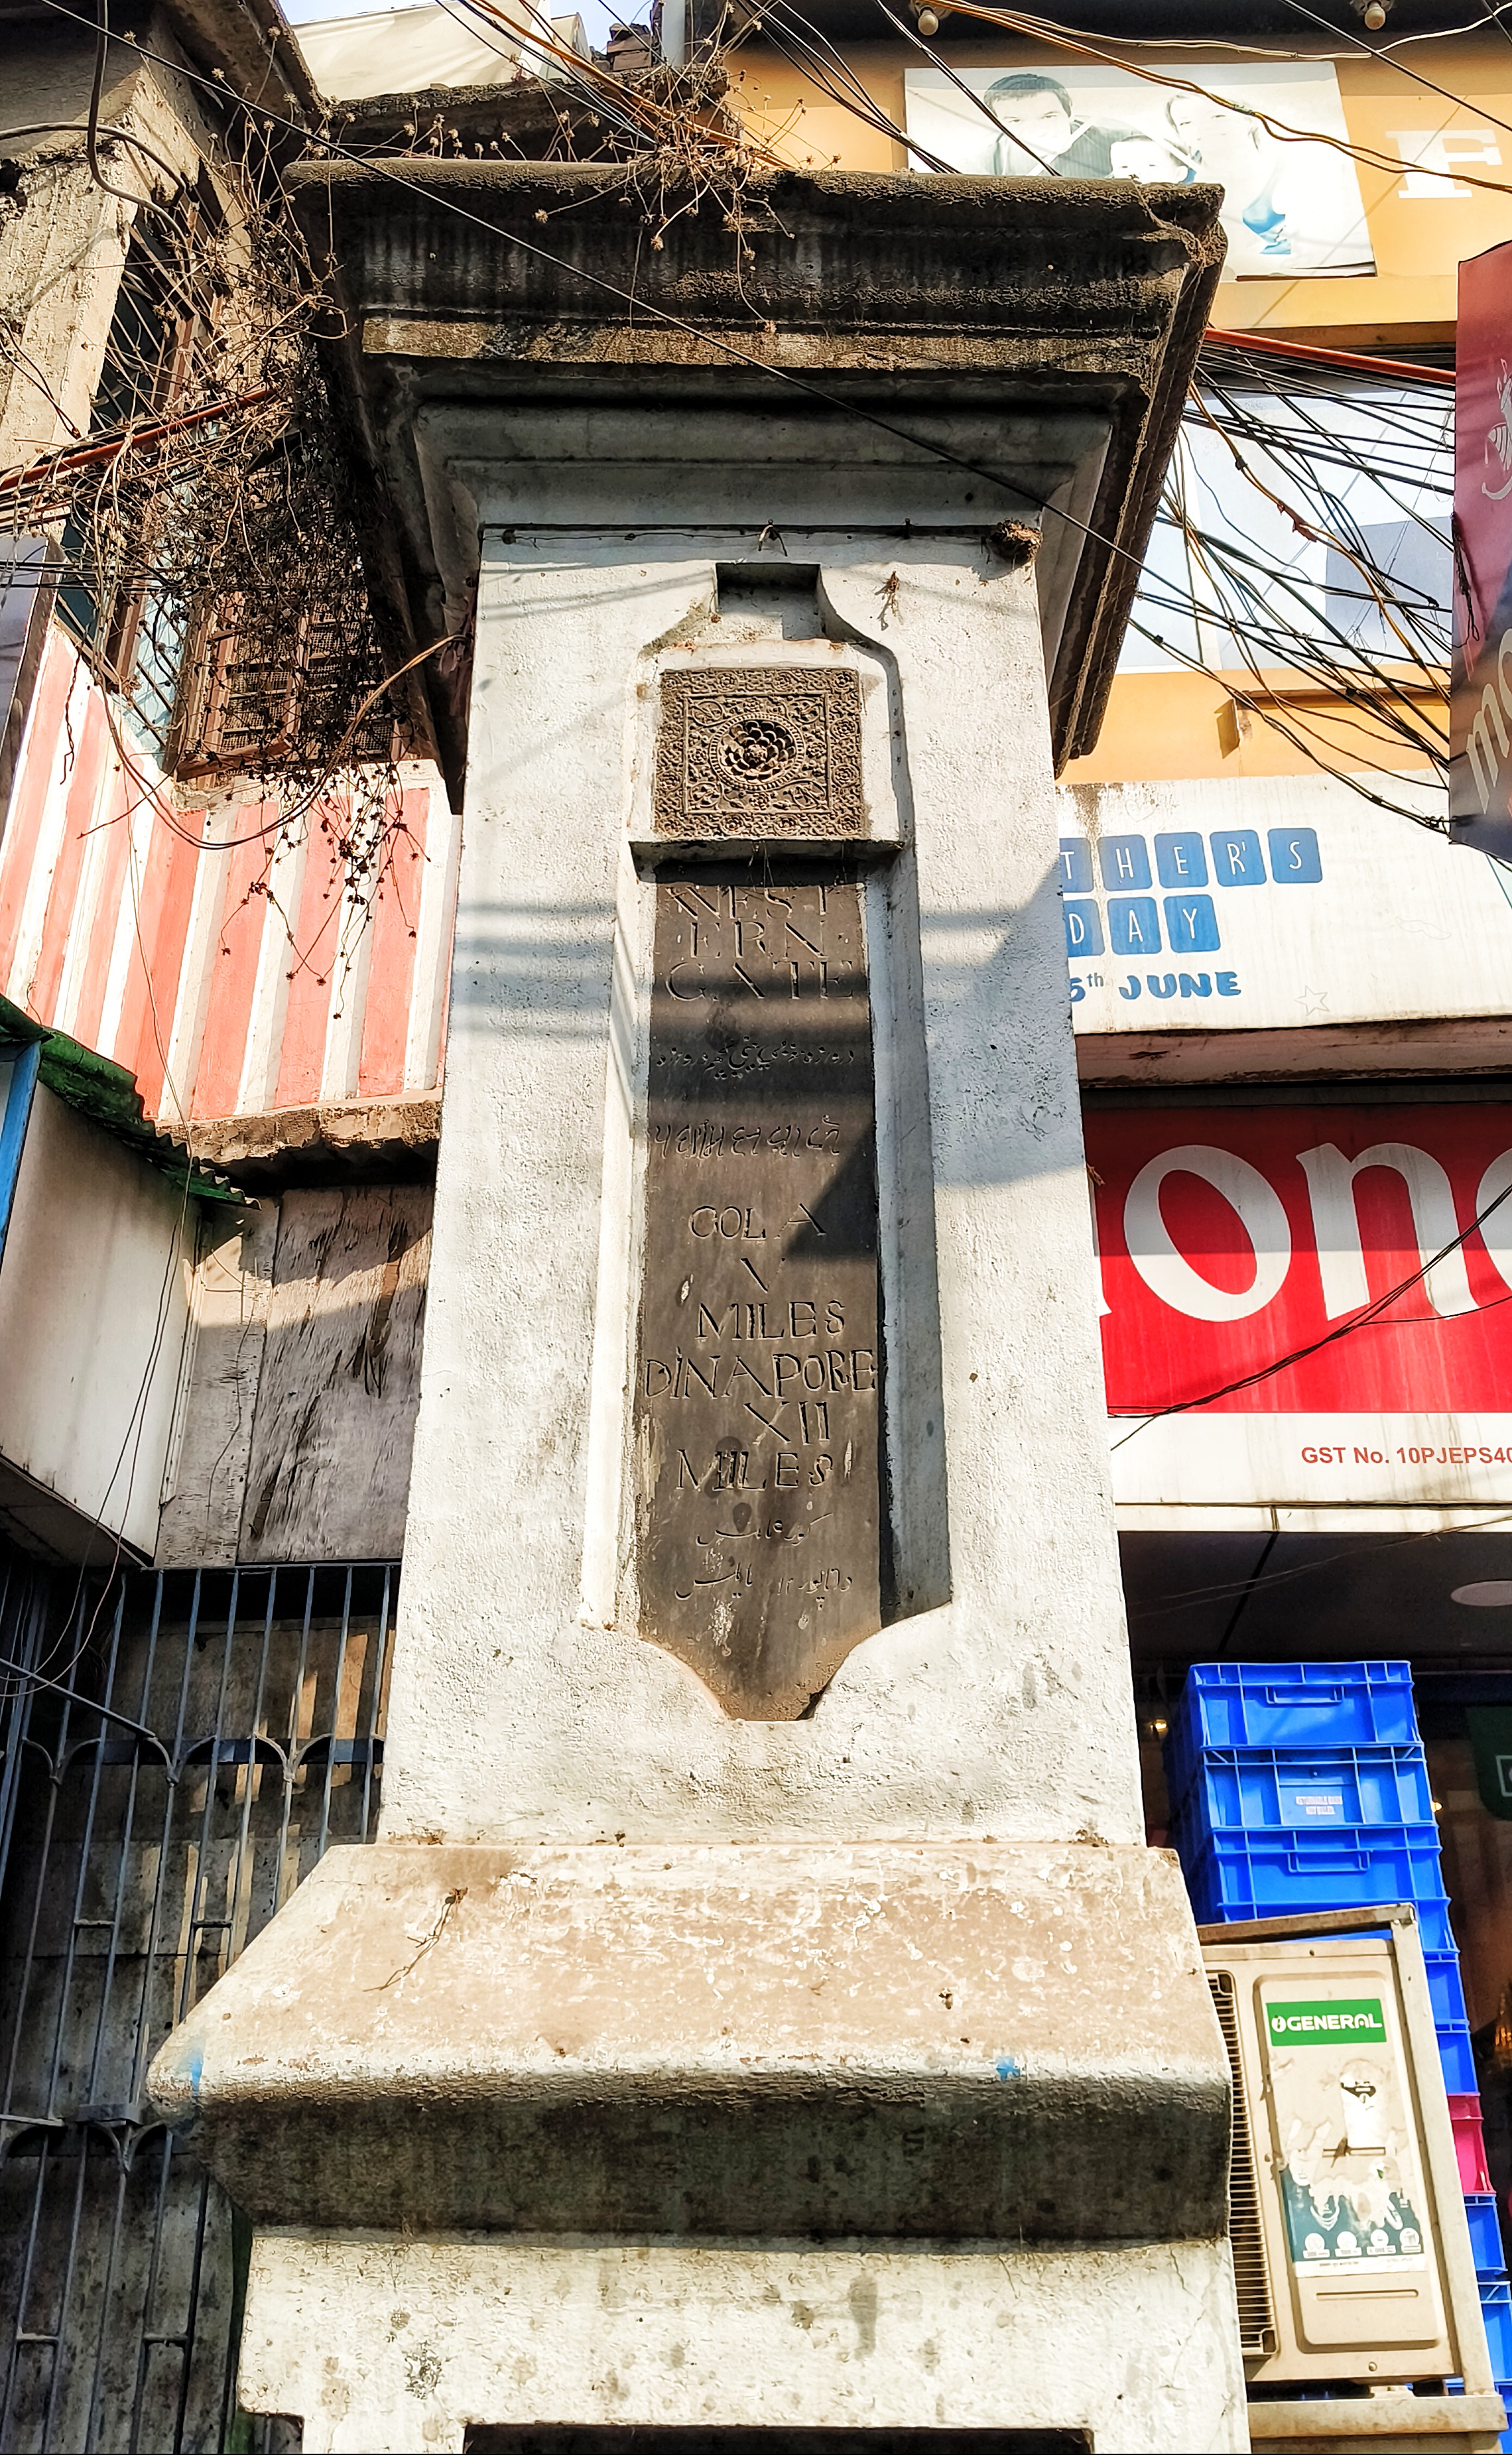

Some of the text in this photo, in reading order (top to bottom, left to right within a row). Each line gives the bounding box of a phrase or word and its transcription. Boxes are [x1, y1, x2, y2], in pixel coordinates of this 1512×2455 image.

[1385, 129, 1502, 198] F
[690, 920, 828, 959] ERN
[1069, 908, 1197, 944] DAY
[665, 961, 853, 1001] GATE
[1118, 972, 1241, 1000] JUNE
[688, 1203, 827, 1240] GOLA
[740, 1257, 787, 1294] V
[694, 1300, 846, 1340] MILES
[644, 1348, 878, 1399] DINAPORE
[743, 1401, 830, 1446] XII
[675, 1449, 834, 1492] MILES
[1302, 1446, 1346, 1464] GST
[1353, 1447, 1390, 1464] No.
[1287, 2013, 1382, 2032] GENERAL
